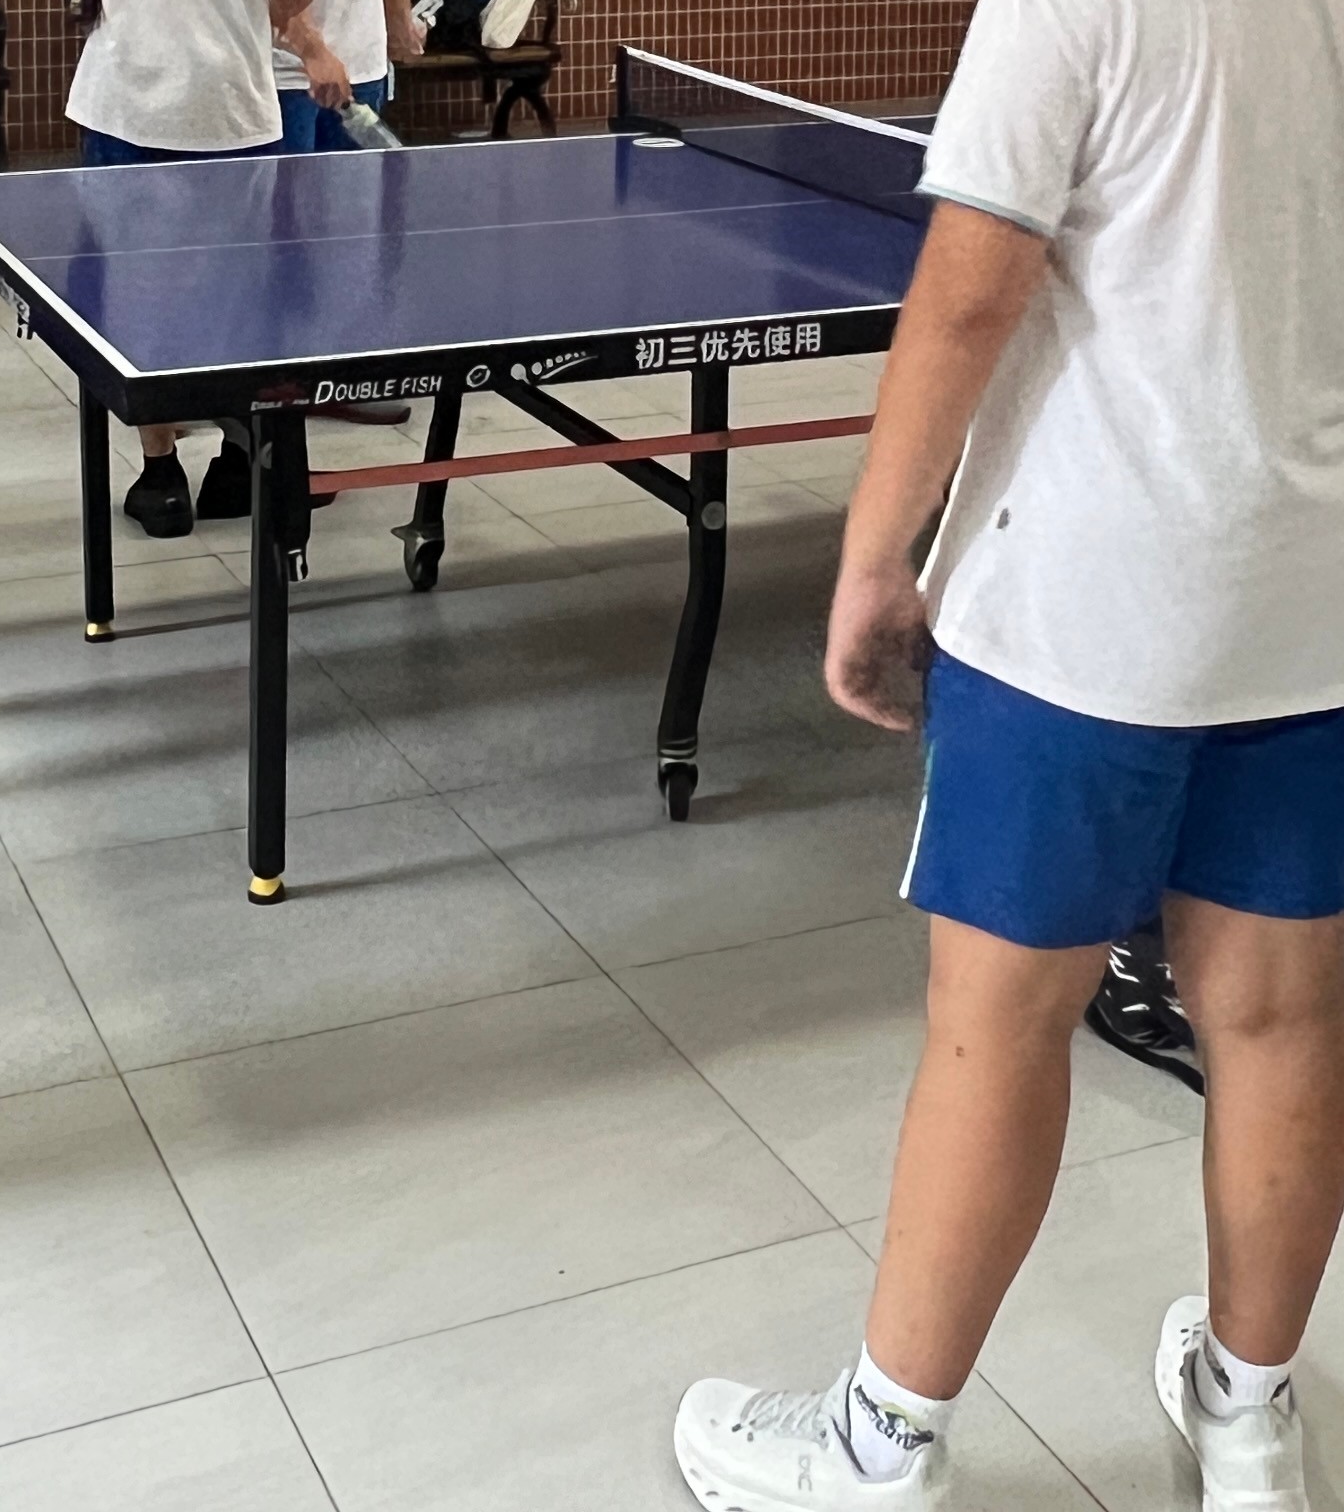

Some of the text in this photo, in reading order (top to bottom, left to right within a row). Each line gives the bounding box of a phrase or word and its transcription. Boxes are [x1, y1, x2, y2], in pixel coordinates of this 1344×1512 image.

[635, 322, 823, 370] 初三优先使用
[314, 378, 397, 405] DOUBLE
[401, 375, 443, 395] FISH
